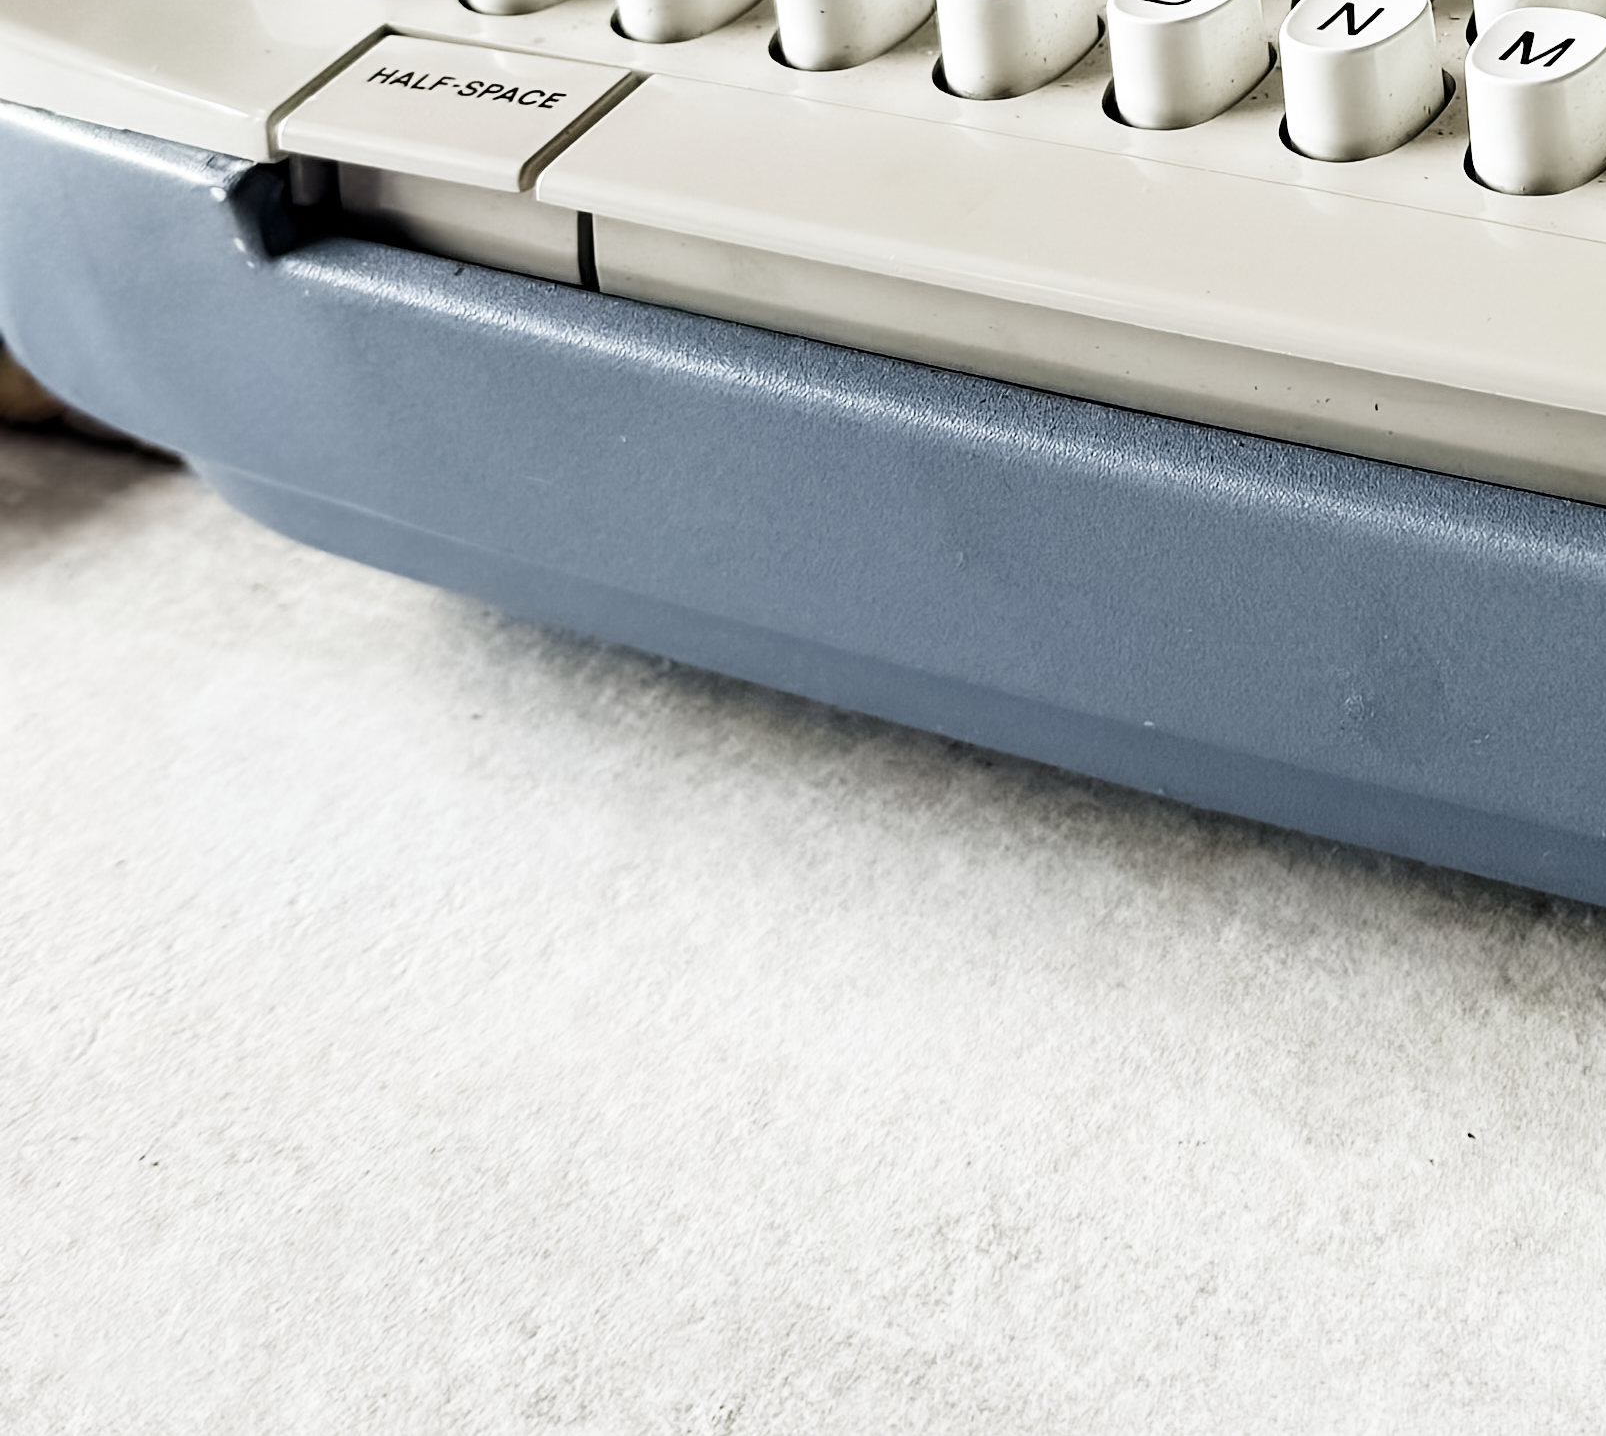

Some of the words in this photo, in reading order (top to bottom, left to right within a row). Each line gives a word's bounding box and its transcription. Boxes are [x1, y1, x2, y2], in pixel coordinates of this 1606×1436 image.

[1317, 3, 1384, 35] N
[1499, 31, 1575, 67] M
[368, 68, 566, 108] HALF-SPACE
